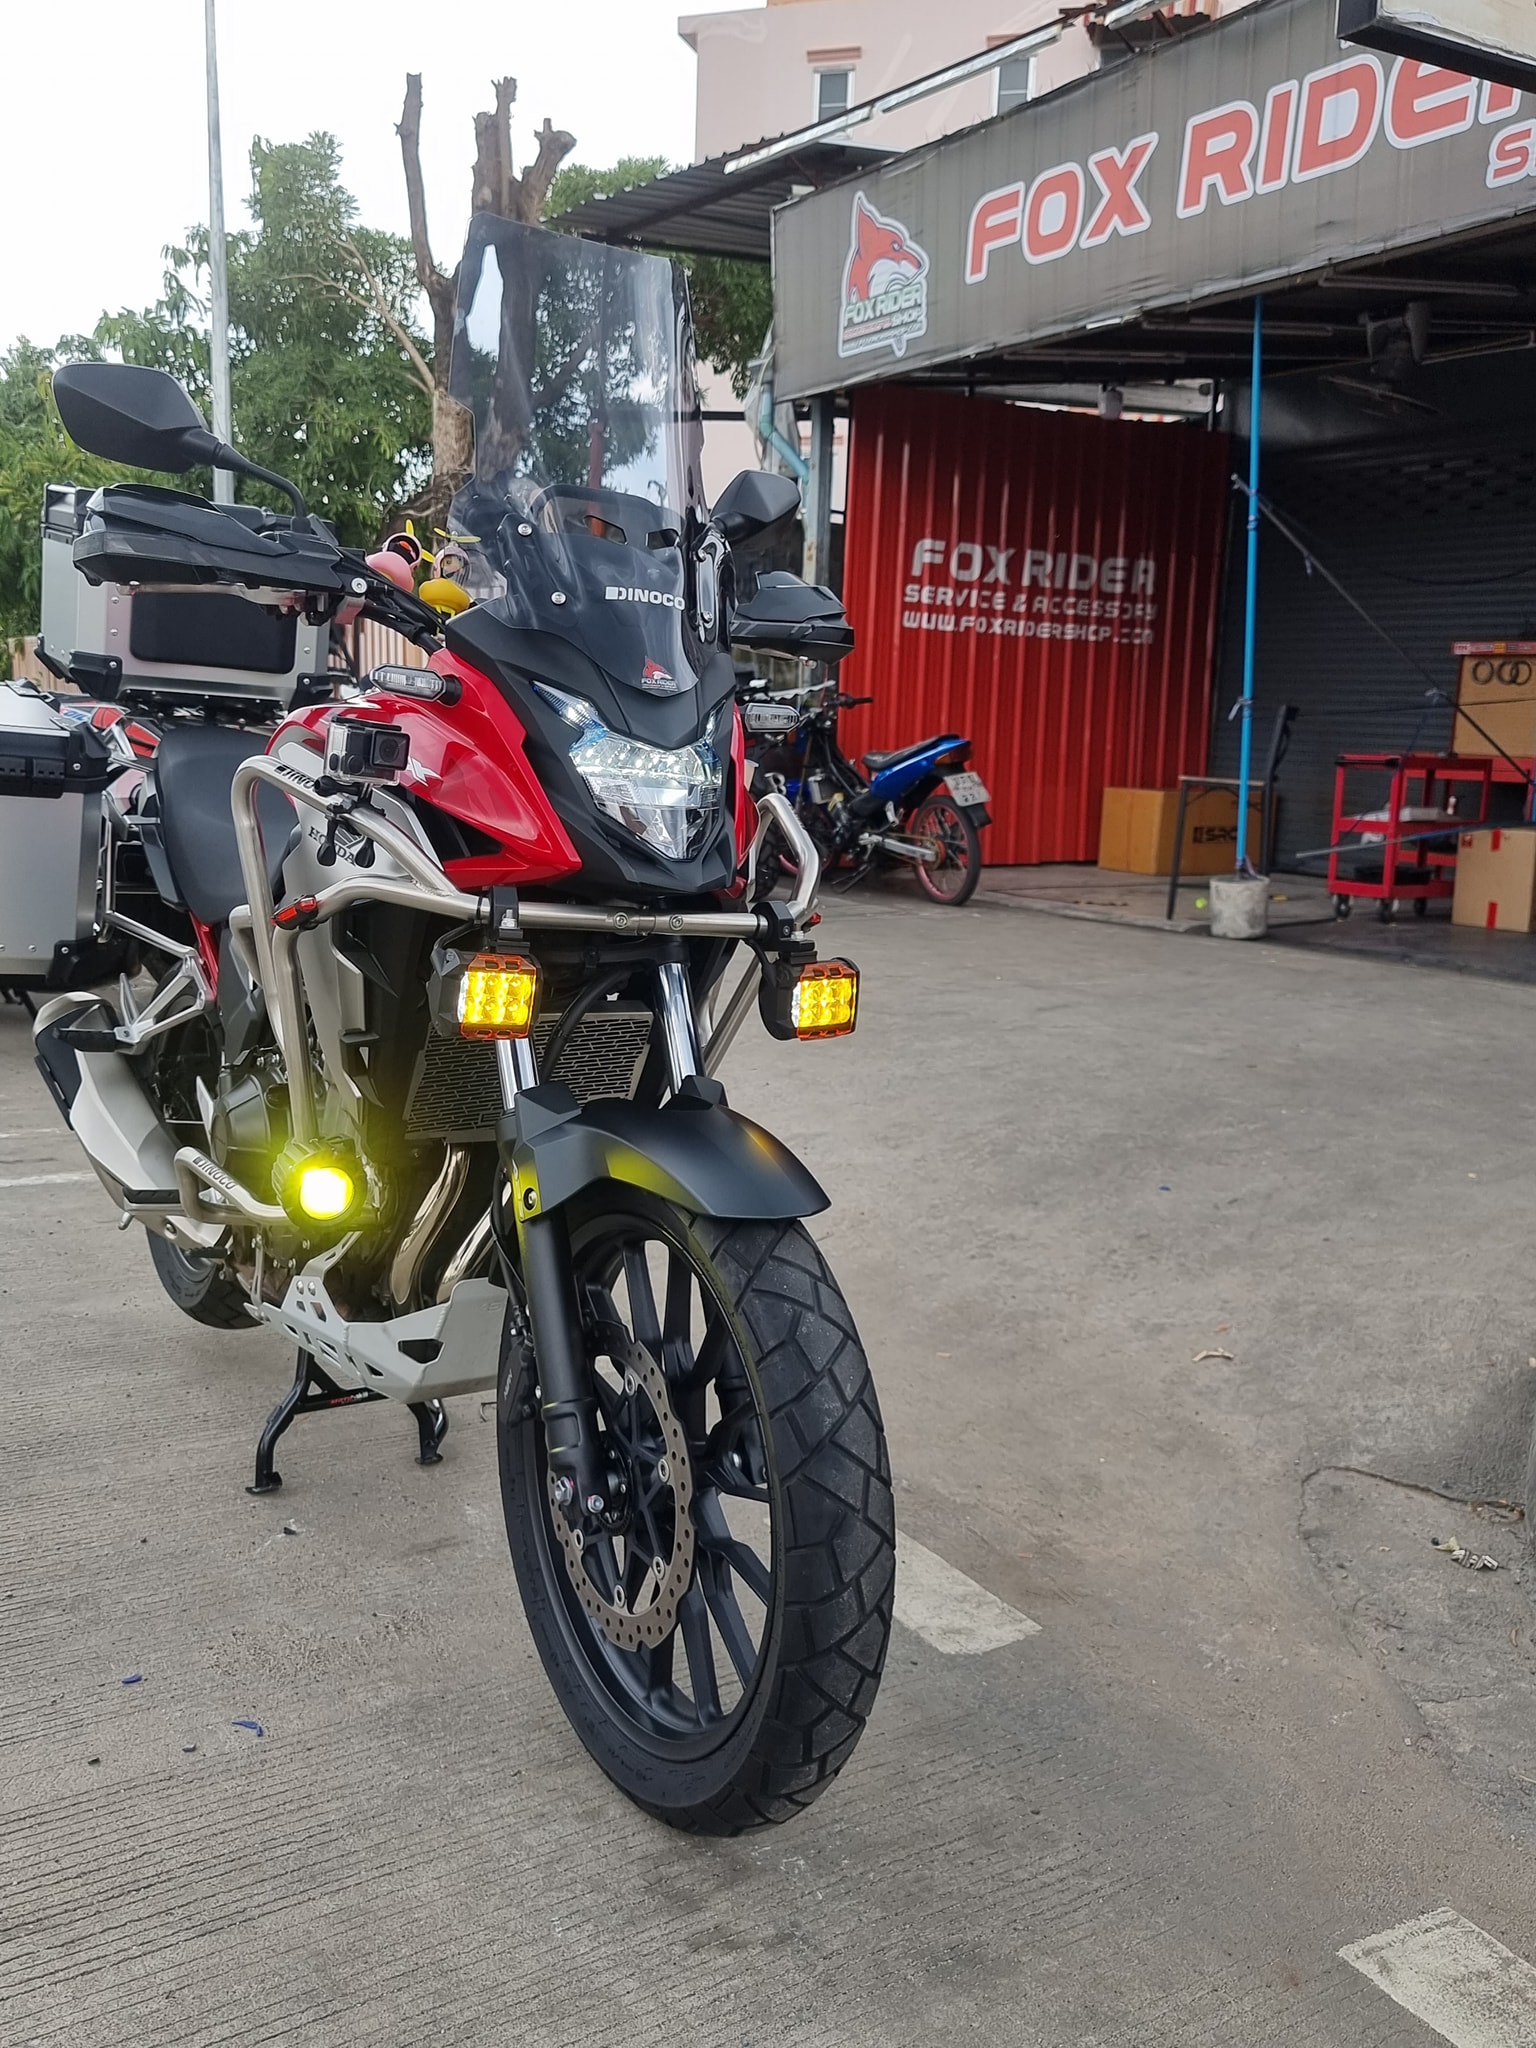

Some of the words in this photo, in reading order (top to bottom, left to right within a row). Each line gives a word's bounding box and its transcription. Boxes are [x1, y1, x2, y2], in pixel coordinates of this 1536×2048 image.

[965, 131, 1159, 284] FOX
[844, 299, 876, 328] FOX
[876, 284, 921, 317] RIDER
[911, 538, 1017, 585] FOX
[1021, 549, 1156, 595] RIDER
[605, 586, 685, 610] DINOCO
[904, 584, 1006, 609] SERVICE
[1012, 594, 1028, 613] &
[308, 826, 356, 867] HODA
[192, 1156, 236, 1189] DINOCO
